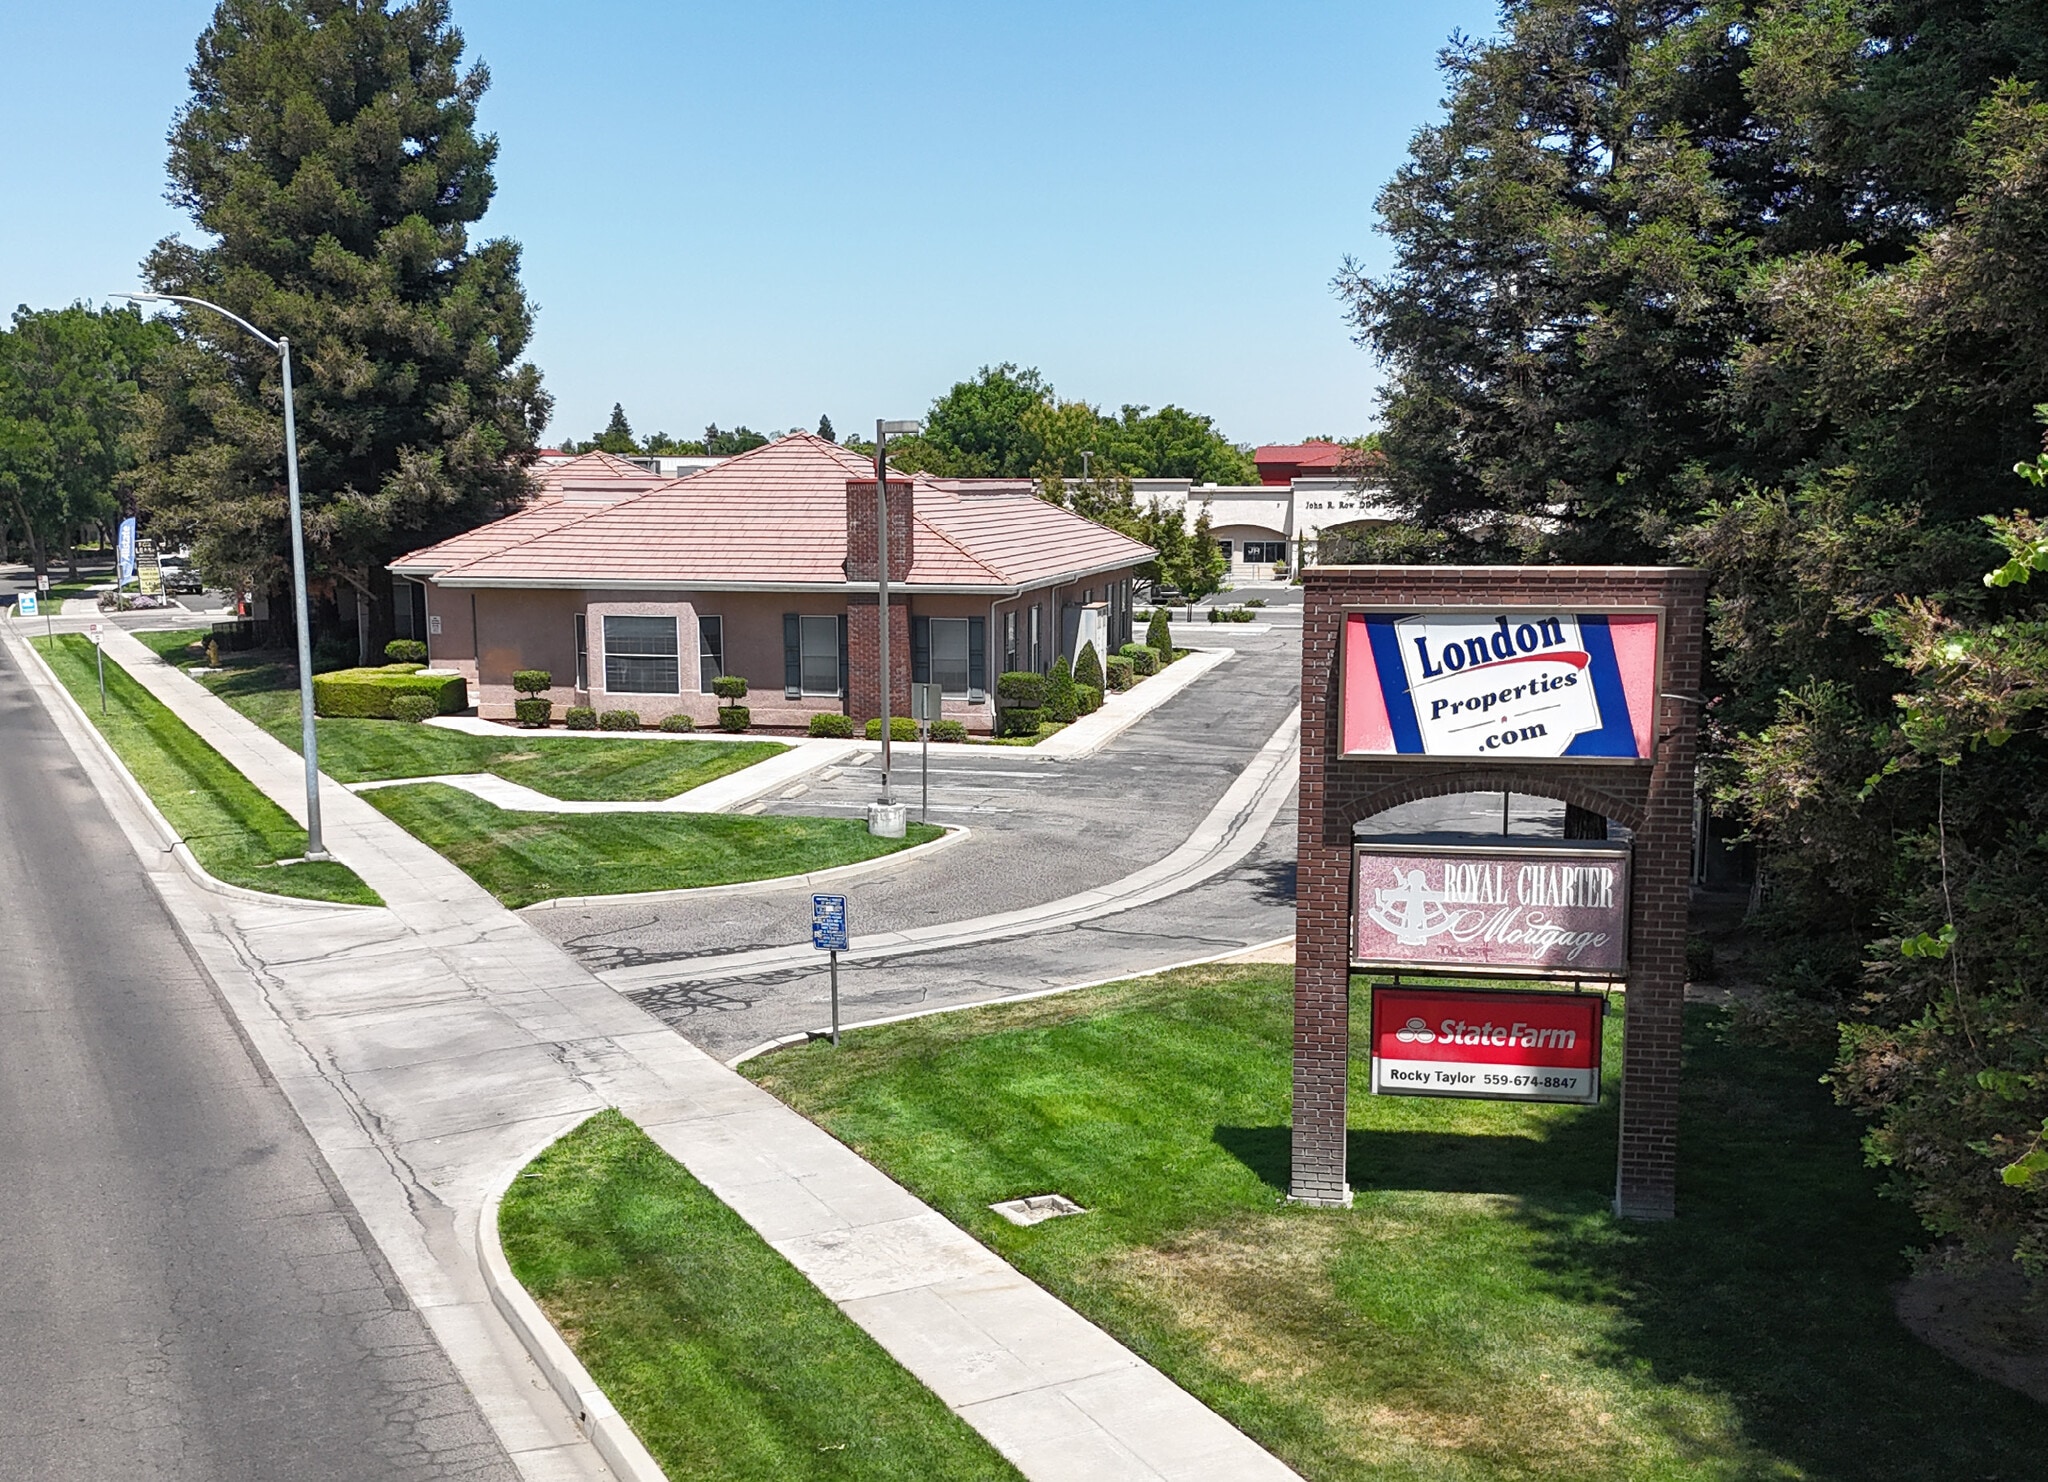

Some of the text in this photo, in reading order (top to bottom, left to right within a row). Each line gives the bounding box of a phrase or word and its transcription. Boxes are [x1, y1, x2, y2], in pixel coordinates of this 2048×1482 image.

[1305, 501, 1323, 510] John
[1339, 501, 1355, 509] Row
[1414, 615, 1566, 679] London
[1430, 673, 1578, 720] Properties
[1479, 723, 1548, 752] .com
[1444, 863, 1614, 908] ROYAL CHARTER
[1450, 905, 1609, 961] Mortgage
[1390, 1069, 1577, 1089] Rocky Taylor 559-674-8847
